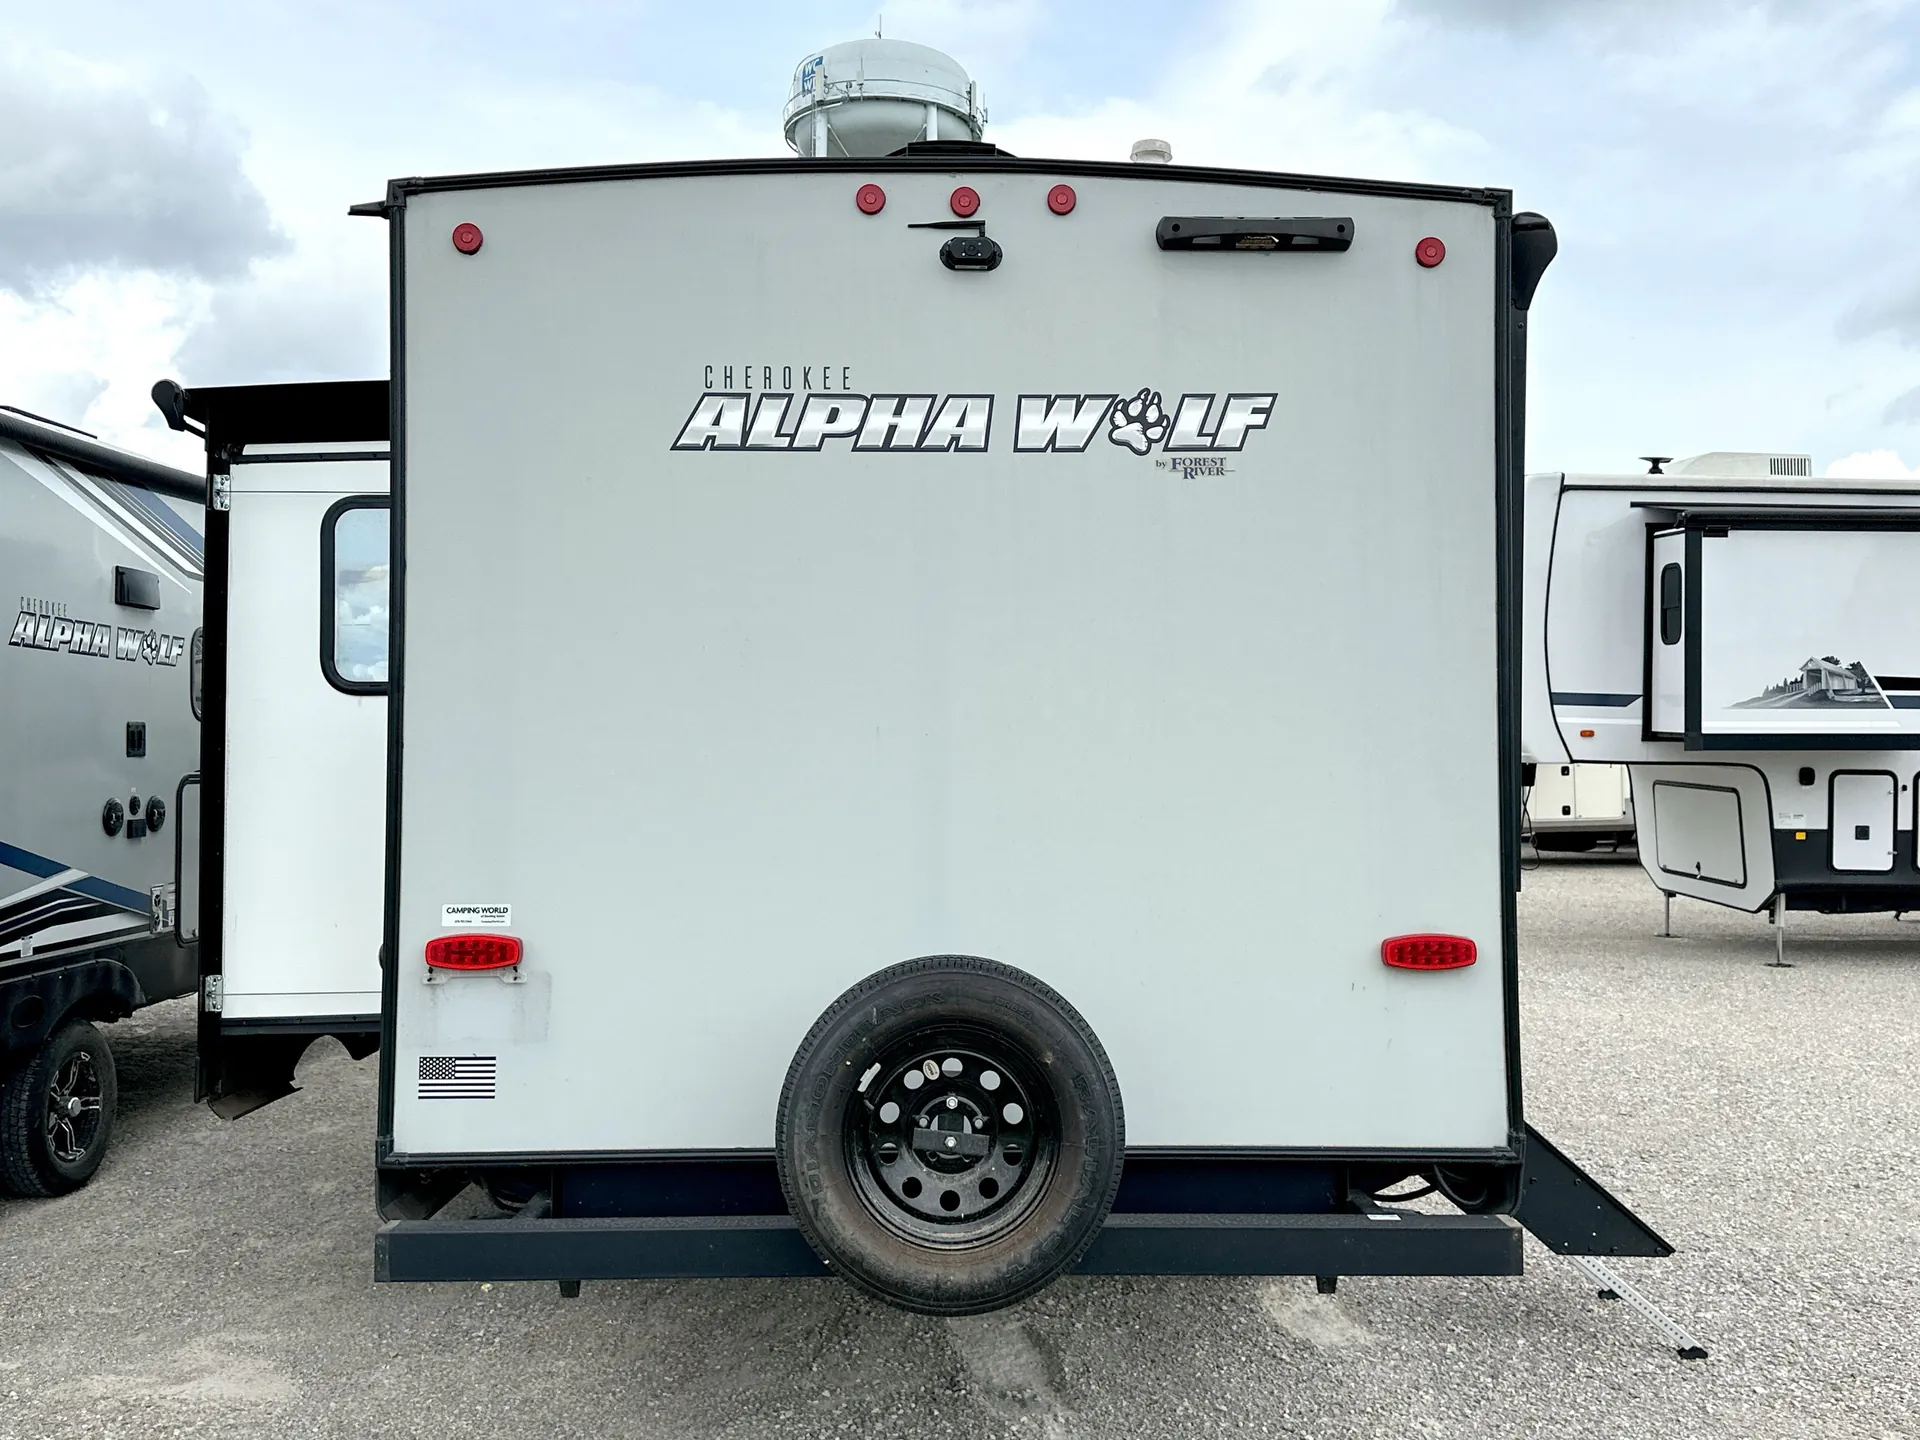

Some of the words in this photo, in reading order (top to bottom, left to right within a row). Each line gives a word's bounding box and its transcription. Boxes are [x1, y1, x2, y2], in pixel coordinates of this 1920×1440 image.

[703, 364, 851, 391] CHEROKEE
[669, 392, 996, 453] ALPHA
[1155, 460, 1167, 468] by
[1170, 457, 1226, 470] FOREST
[1183, 467, 1225, 480] RIVER
[20, 596, 68, 618] CHEROKEE
[8, 610, 112, 659] ALPHA
[446, 906, 480, 914] CAMPING
[480, 906, 509, 914] WORLD
